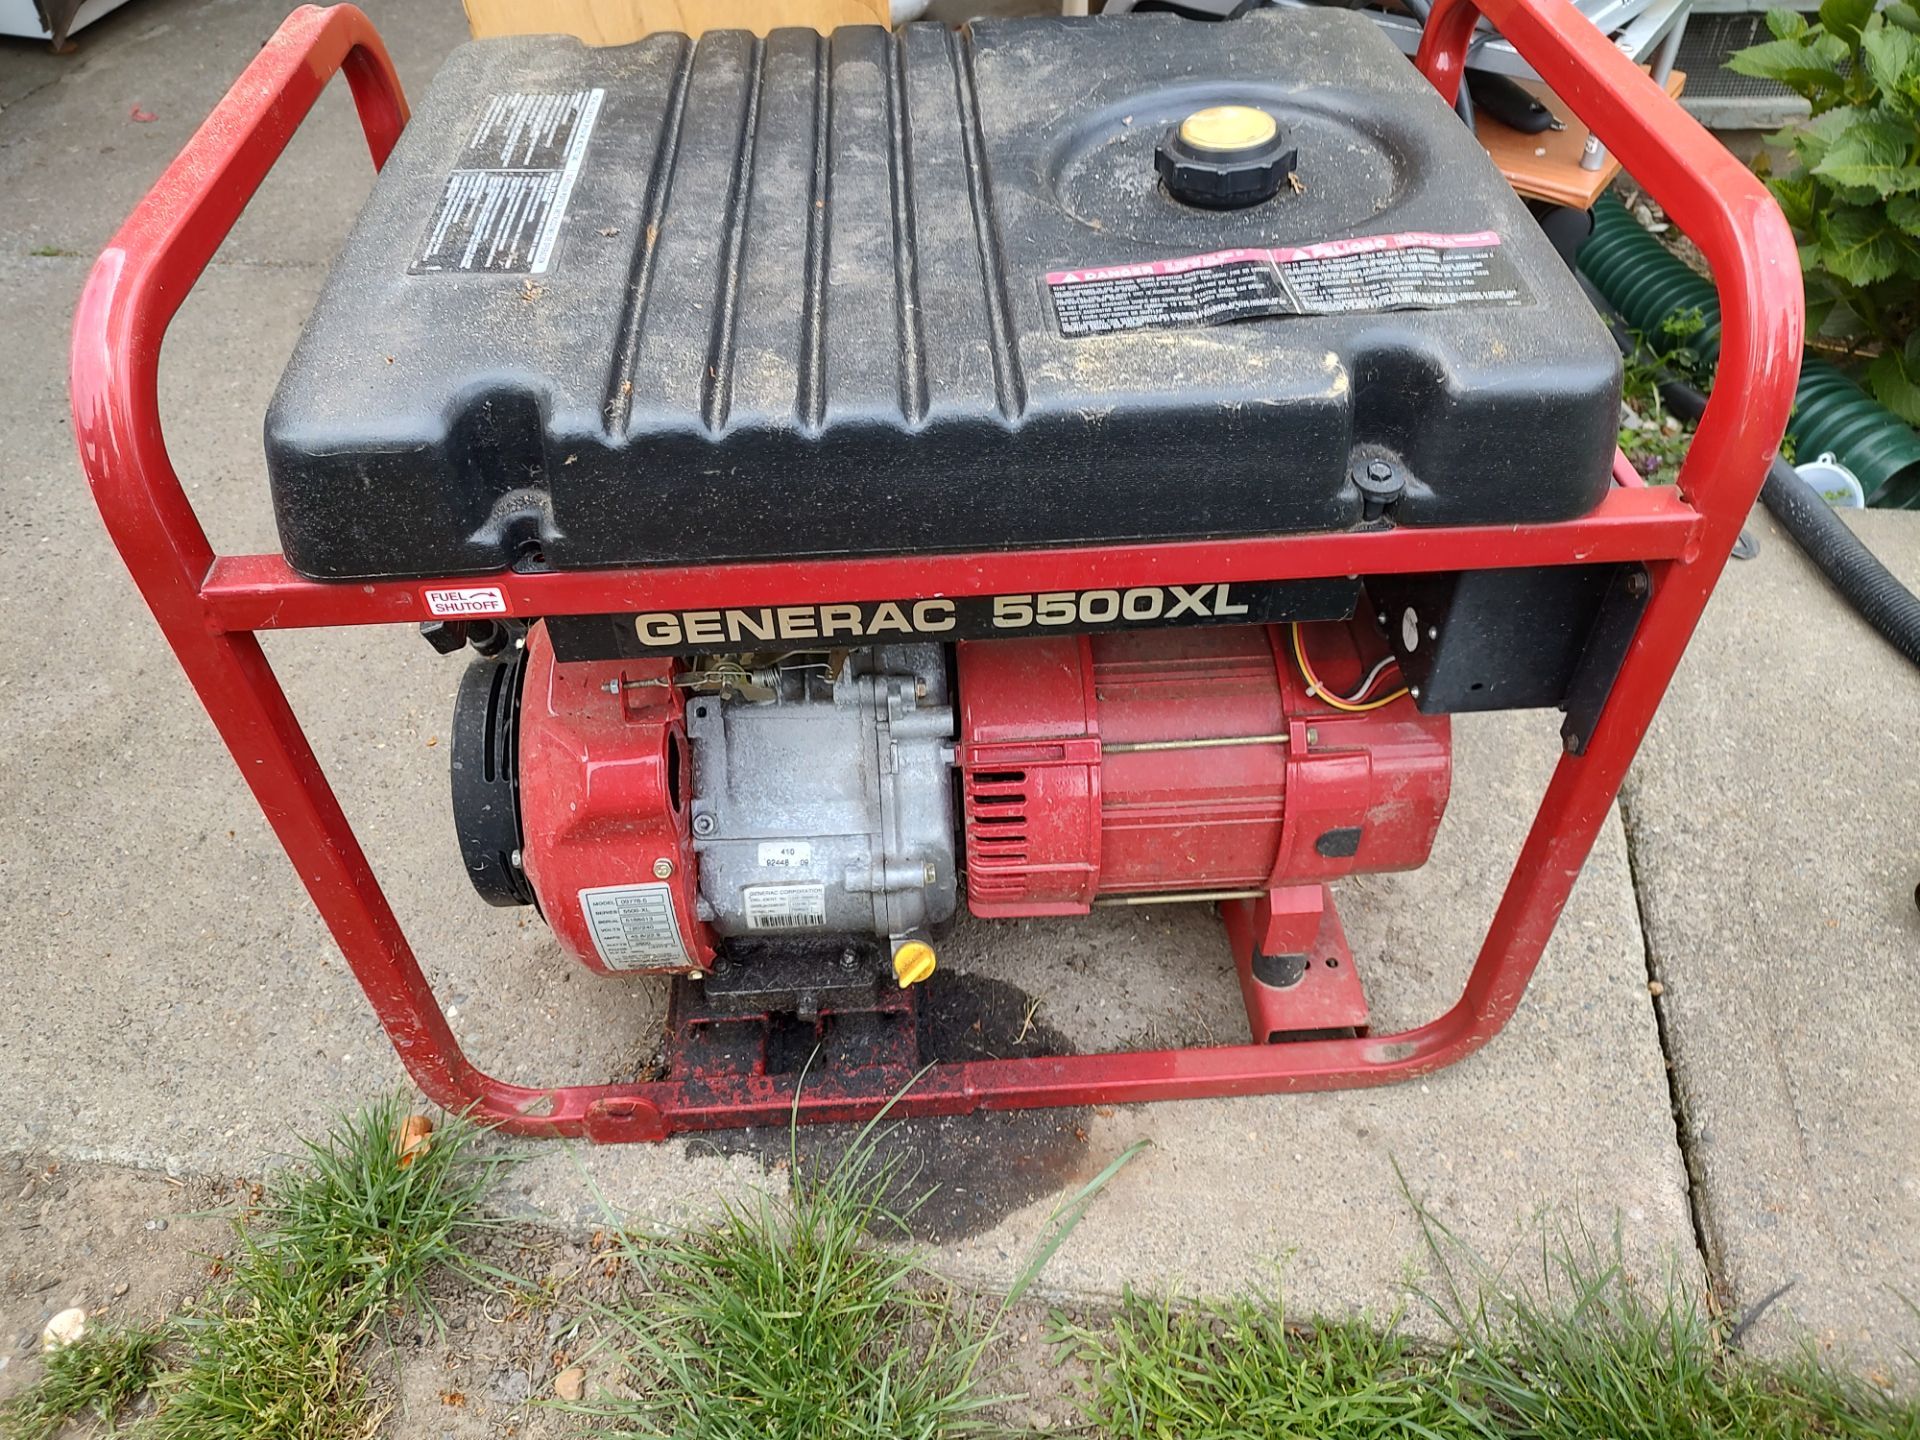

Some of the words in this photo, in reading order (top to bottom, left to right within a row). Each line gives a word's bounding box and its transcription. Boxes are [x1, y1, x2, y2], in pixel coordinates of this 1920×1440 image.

[1084, 265, 1153, 281] DANGER
[431, 592, 468, 602] FUEL
[435, 601, 499, 612] SHUTOFF
[634, 599, 957, 648] GENERAC
[992, 584, 1249, 627] 5500XL
